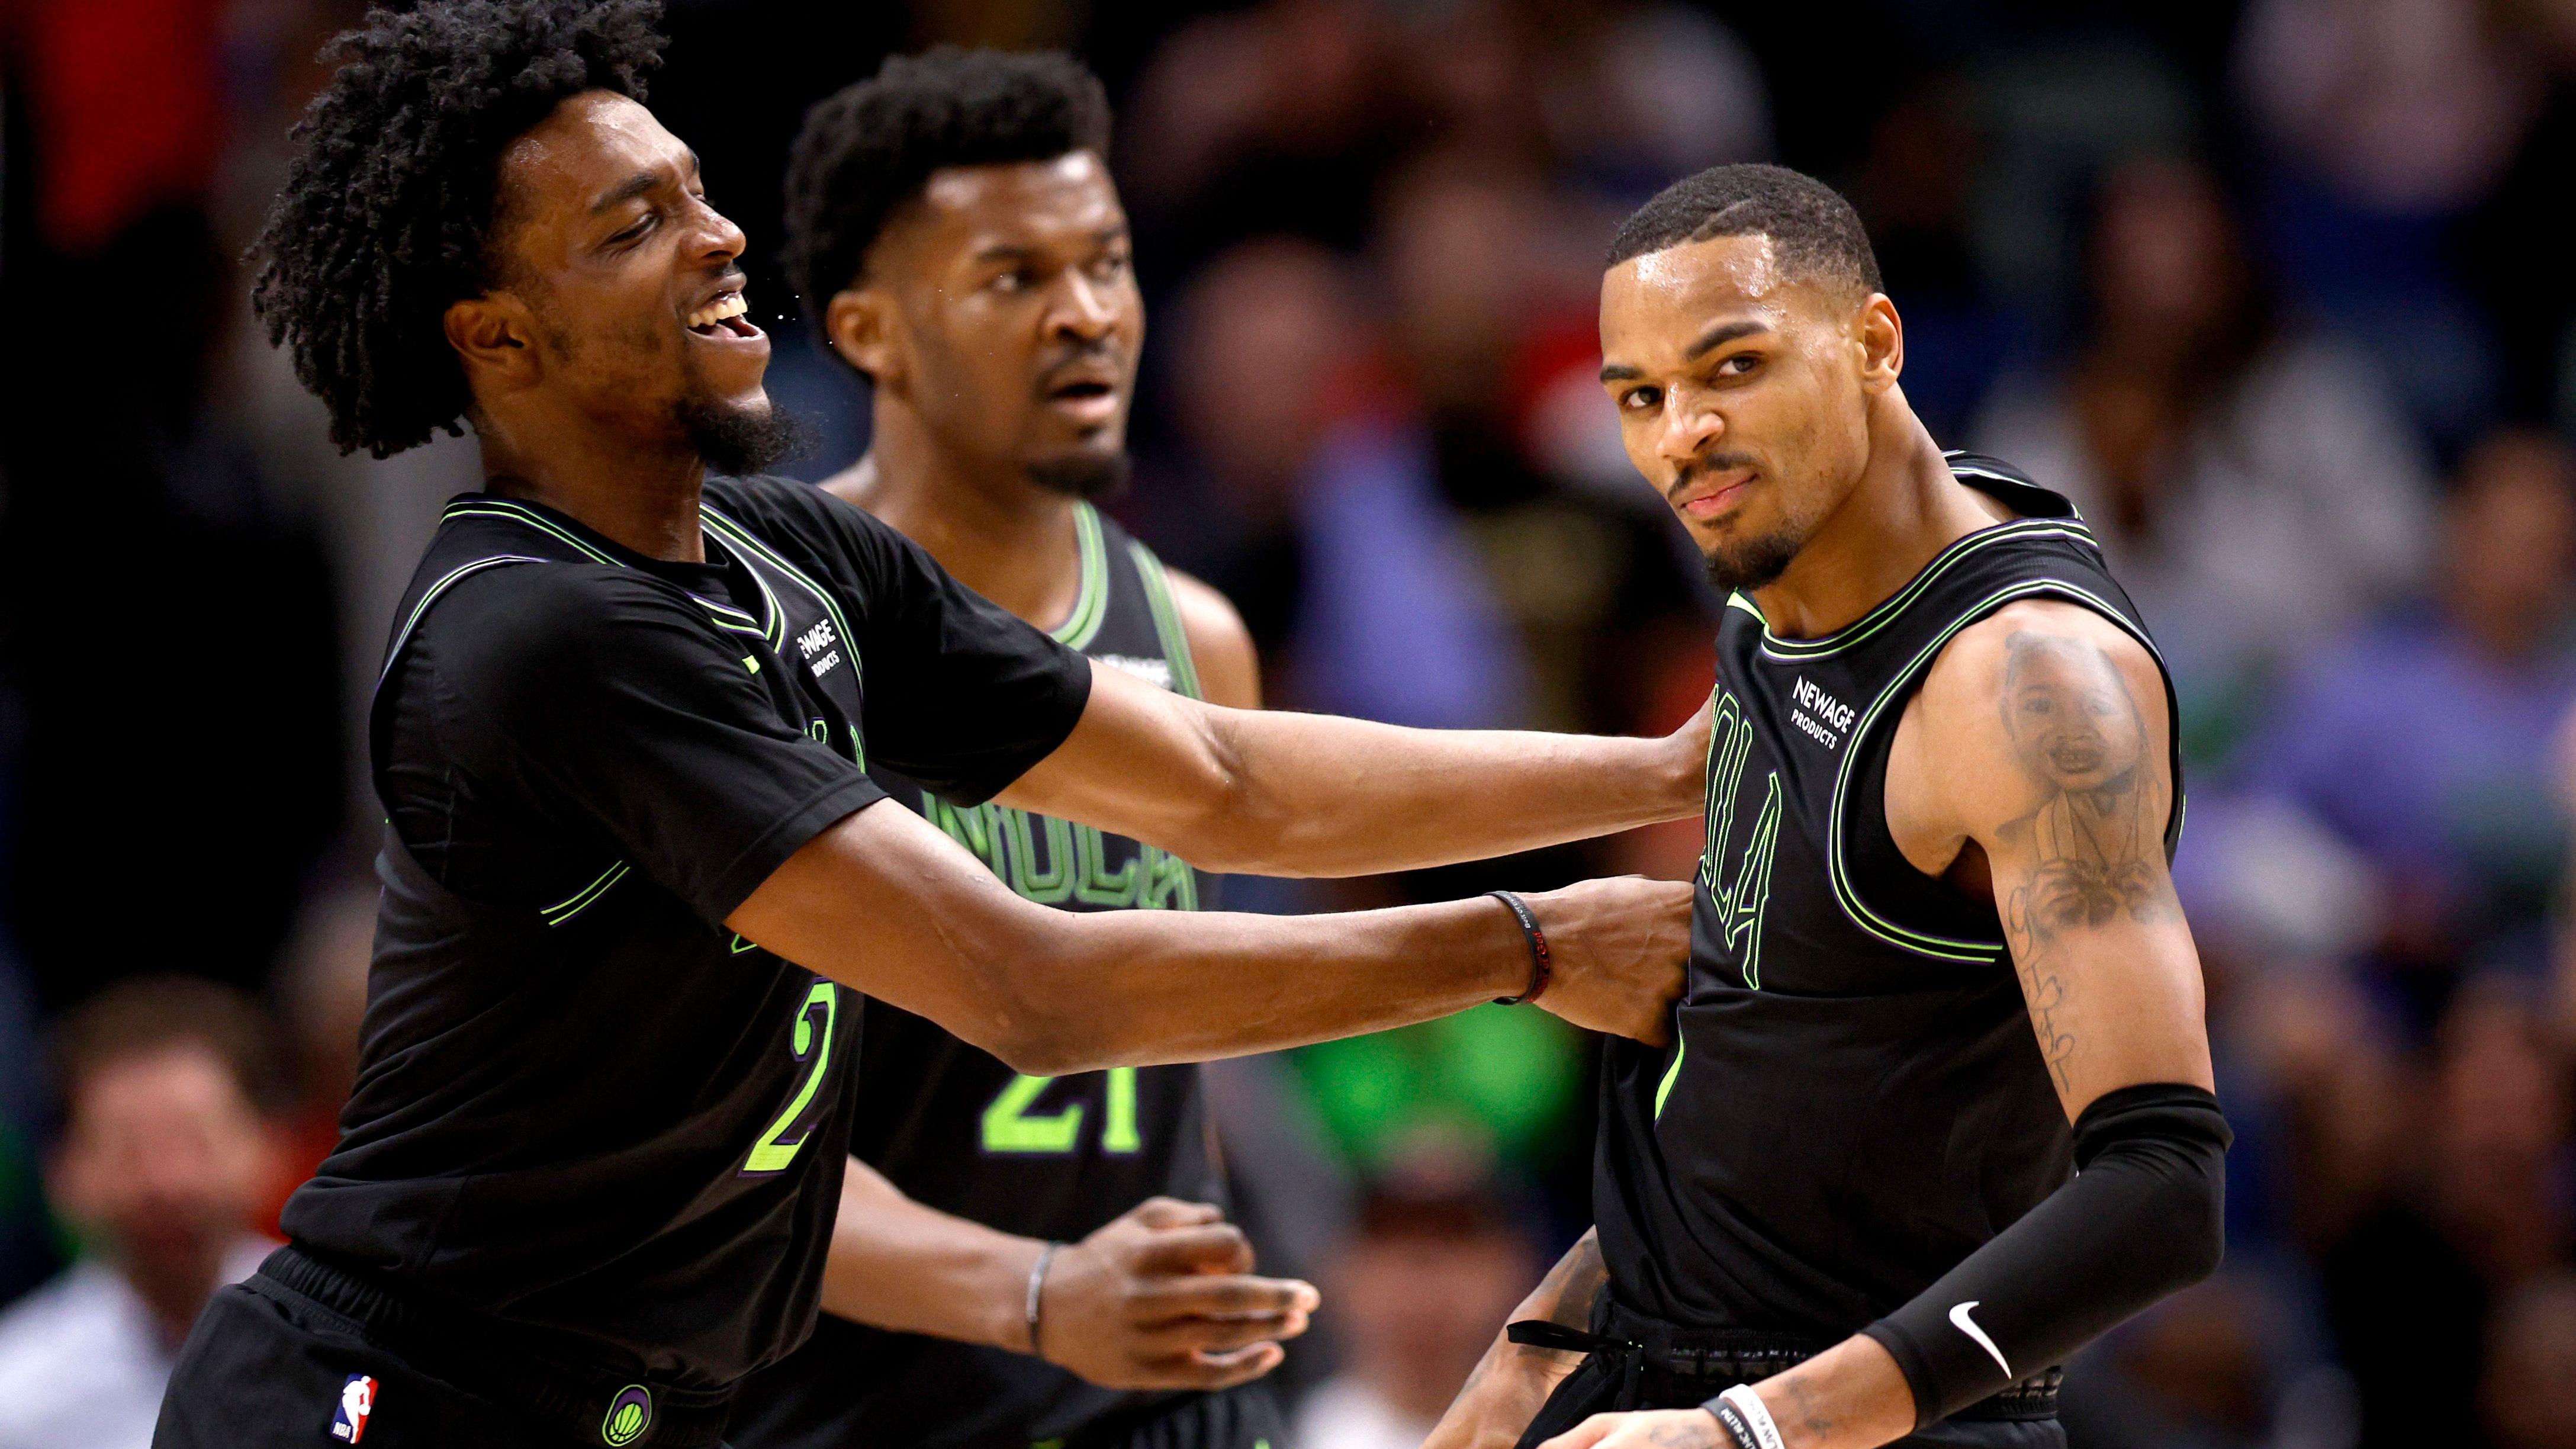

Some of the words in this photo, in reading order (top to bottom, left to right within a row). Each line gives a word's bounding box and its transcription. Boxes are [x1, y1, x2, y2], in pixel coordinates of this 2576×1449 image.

[1790, 708, 1838, 750] PRODUCTS
[1792, 674, 1855, 734] NEWAGE
[1700, 683, 1782, 991] OLA
[742, 980, 837, 1172] 2
[332, 1421, 352, 1439] NBA
